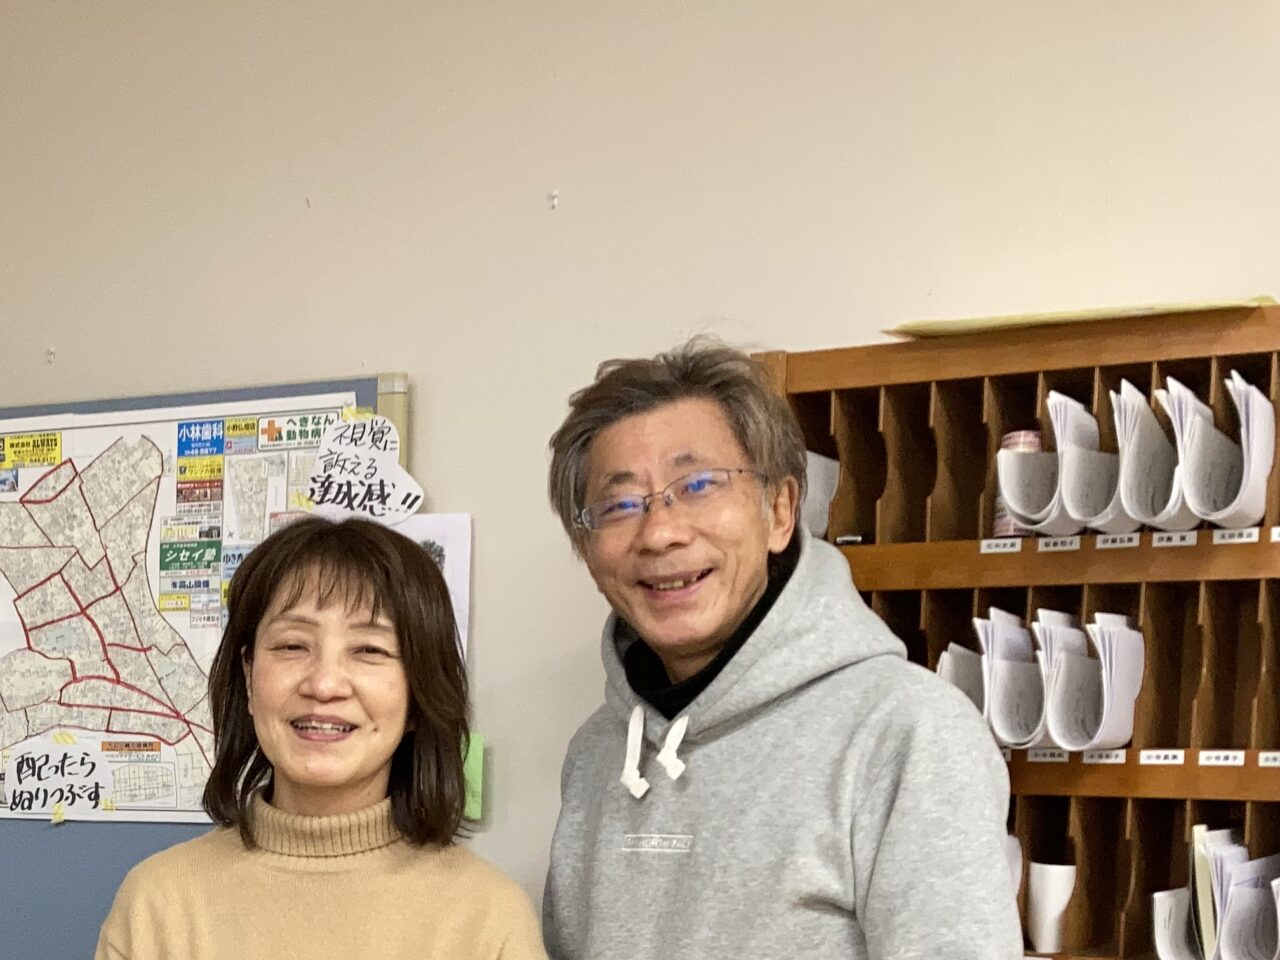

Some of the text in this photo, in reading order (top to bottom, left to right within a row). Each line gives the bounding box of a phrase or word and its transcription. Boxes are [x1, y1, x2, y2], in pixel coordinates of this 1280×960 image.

[178, 421, 223, 442] 小林歯科
[286, 414, 336, 427] へきなん
[32, 438, 58, 448] ALWAYS
[332, 418, 399, 452] 視覚に
[319, 448, 378, 481] 訴える
[165, 547, 217, 563] シセイ塾
[16, 750, 97, 784] 配ったら
[9, 781, 106, 812] ぬりつぶす
